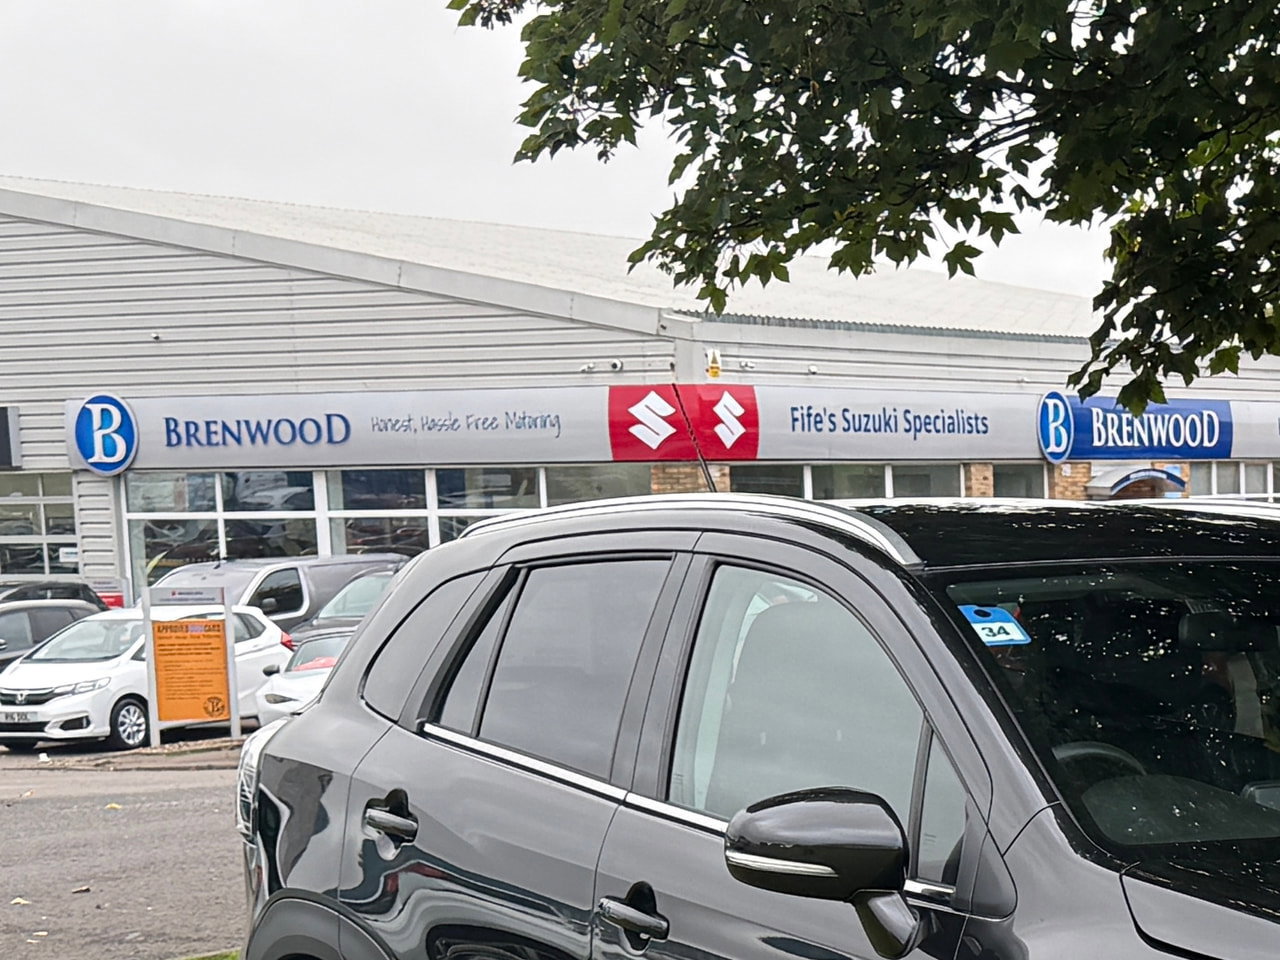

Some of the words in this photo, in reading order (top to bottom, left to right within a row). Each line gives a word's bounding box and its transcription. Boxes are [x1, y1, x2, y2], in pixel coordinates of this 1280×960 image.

[84, 403, 127, 463] B
[163, 413, 351, 447] BRENWOOD
[371, 414, 417, 434] Honest,
[421, 411, 461, 432] Hassle
[465, 413, 499, 430] Free
[505, 411, 561, 438] Motoring
[790, 405, 837, 432] Fife's
[841, 407, 898, 433] Suzuki
[903, 409, 989, 440] Specialists
[1045, 398, 1068, 453] B
[1091, 407, 1220, 447] BRENWOOD
